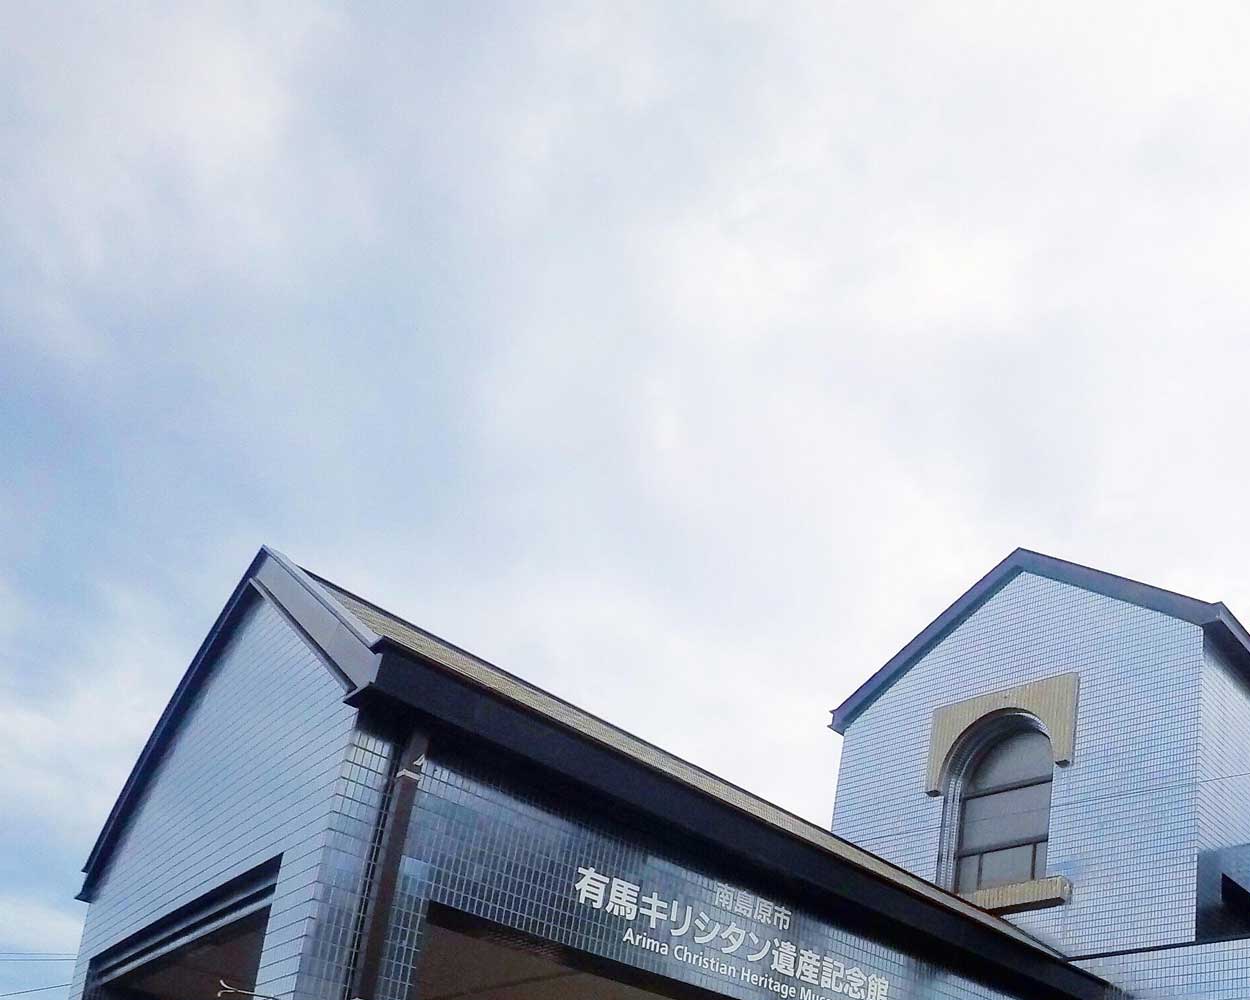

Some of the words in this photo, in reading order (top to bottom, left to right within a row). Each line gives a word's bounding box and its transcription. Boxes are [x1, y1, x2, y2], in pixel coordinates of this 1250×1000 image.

[713, 882, 792, 931] 南島原市
[622, 927, 669, 956] Arima
[673, 945, 737, 978] Christian
[740, 966, 797, 1000] Heritage
